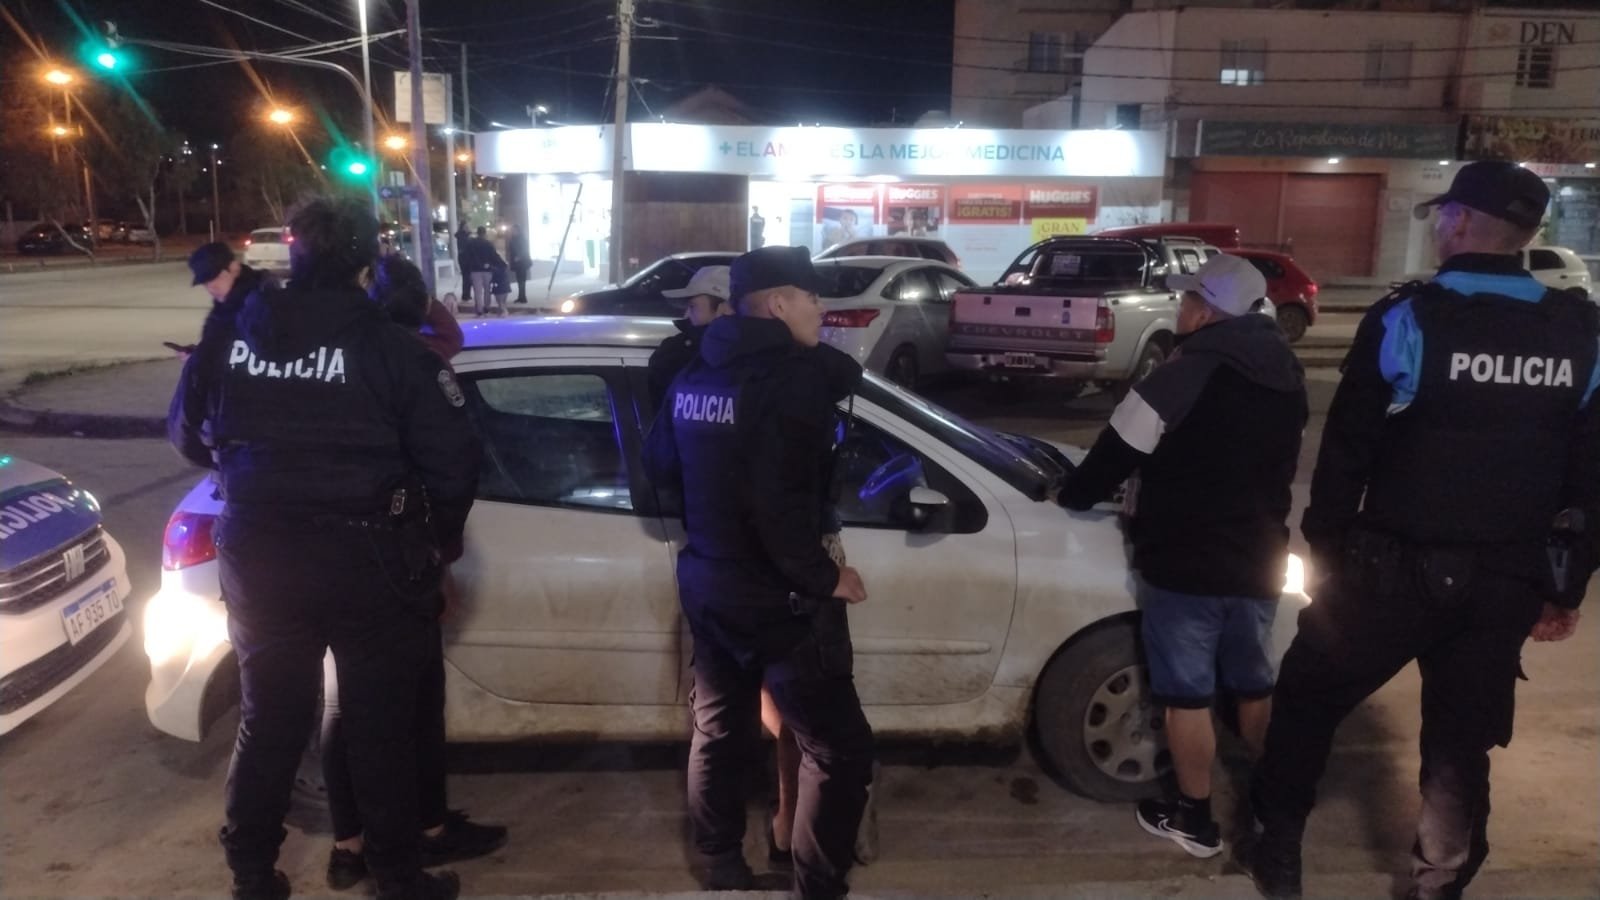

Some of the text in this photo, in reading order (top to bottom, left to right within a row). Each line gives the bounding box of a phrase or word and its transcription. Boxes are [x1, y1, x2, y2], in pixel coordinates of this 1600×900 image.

[1519, 22, 1576, 45] DEN
[736, 141, 760, 157] EL
[859, 143, 885, 159] LA
[966, 145, 1065, 161] MEDICINA
[1030, 190, 1090, 203] HUGGIES
[1041, 222, 1080, 233] GRAN
[961, 325, 1083, 340] CHEVROLET
[1449, 352, 1573, 387] POLICIA
[673, 392, 734, 425] POLICIA
